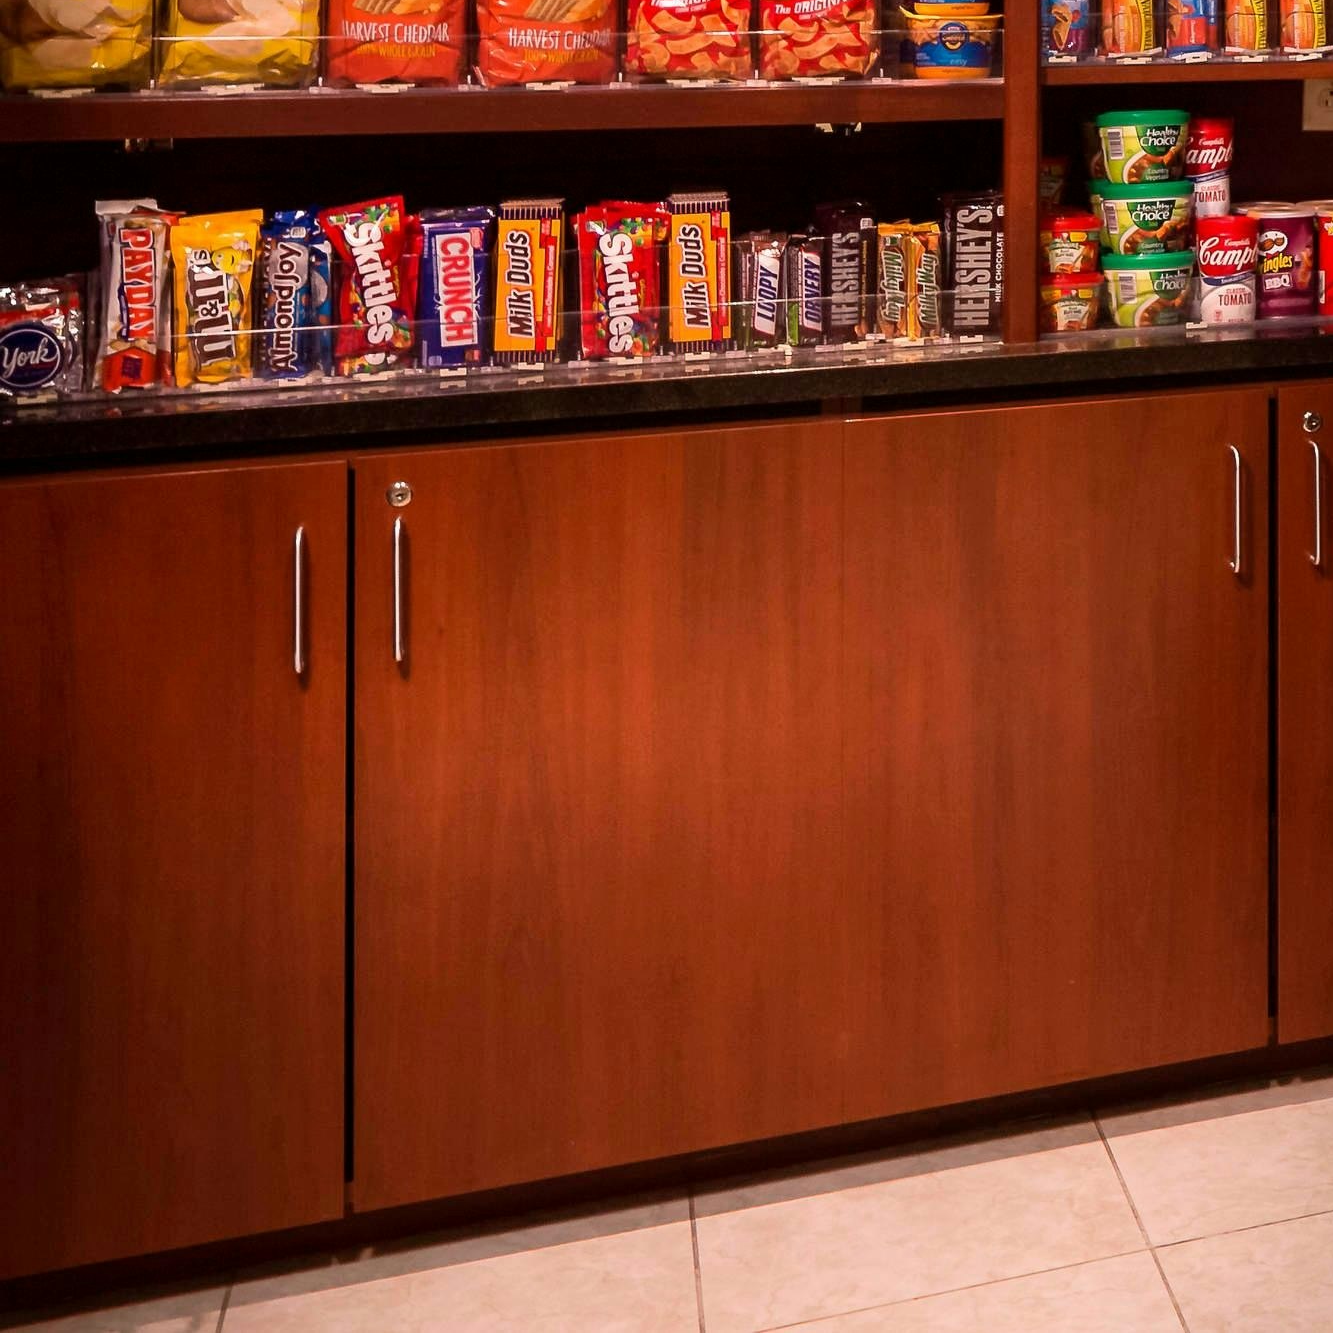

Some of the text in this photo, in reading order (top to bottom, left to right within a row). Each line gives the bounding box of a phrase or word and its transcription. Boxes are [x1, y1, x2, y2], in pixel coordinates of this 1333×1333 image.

[394, 21, 450, 45] CHEDDAR
[775, 3, 791, 14] The
[508, 27, 559, 50] HARVEST
[1140, 136, 1176, 148] Choice
[1132, 210, 1170, 222] Choice
[1194, 191, 1227, 203] TOMATO
[120, 228, 157, 342] PAYDAY
[343, 221, 398, 345] Skittles
[440, 236, 476, 343] CRUNCH
[505, 229, 536, 339] Milk Duds
[599, 232, 640, 354] Skittles
[676, 223, 712, 329] Milk Duds
[830, 232, 861, 327] HERSHEY'S
[880, 249, 905, 292] Milky
[954, 209, 994, 327] HERSHEY'S
[995, 232, 1005, 303] MILK CHOCOLATE
[1264, 275, 1291, 289] BBQ
[269, 241, 304, 372] Almond Joy
[918, 284, 941, 325] Milky
[1, 336, 53, 378] York
